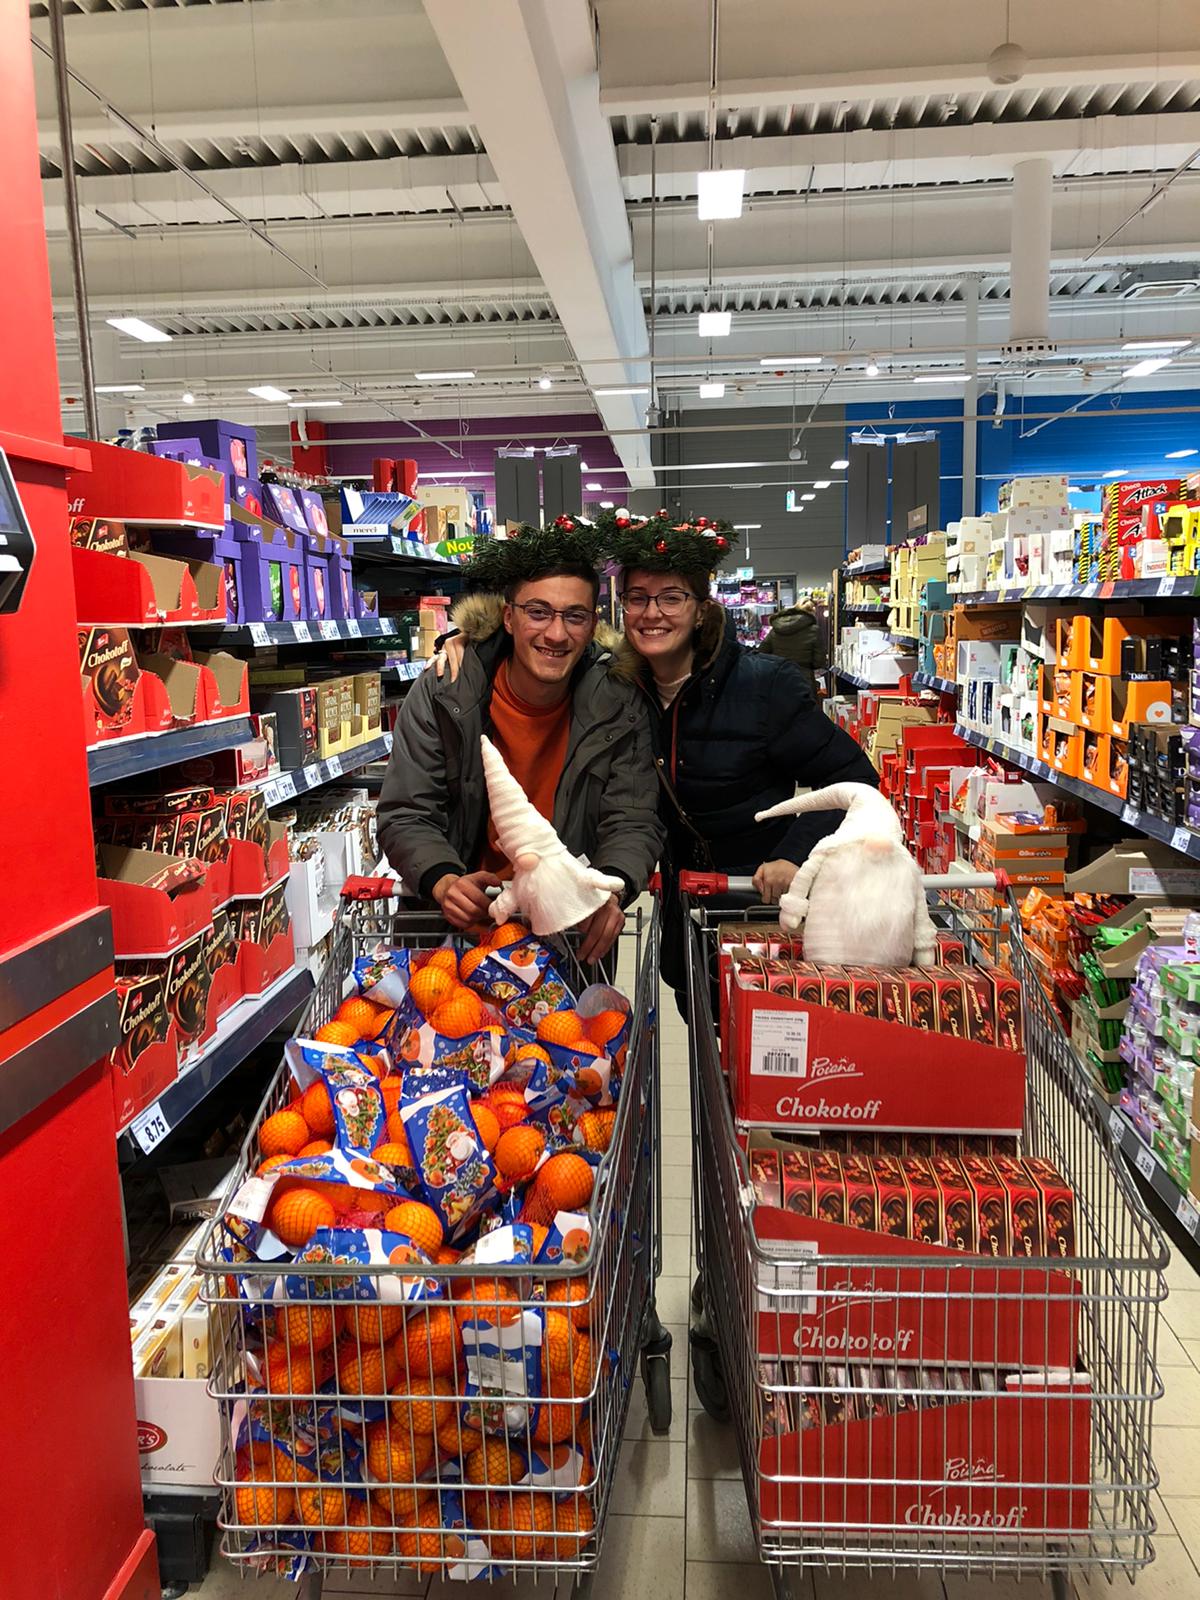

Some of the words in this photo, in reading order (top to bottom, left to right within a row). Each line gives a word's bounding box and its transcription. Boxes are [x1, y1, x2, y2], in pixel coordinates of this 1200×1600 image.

[1120, 482, 1141, 492] Choco
[1122, 483, 1168, 506] Attack
[352, 526, 378, 534] merci
[1119, 518, 1140, 527] Choco
[87, 639, 129, 668] Chokotoff
[169, 951, 203, 995] Chokotoff
[123, 991, 161, 1034] Chokotoff
[810, 1057, 857, 1078] Poiana
[775, 1096, 882, 1120] Chokotoff
[145, 1116, 165, 1143] 8.75
[793, 1326, 915, 1352] Chokotoff
[904, 1504, 1028, 1529] Chokotoff
